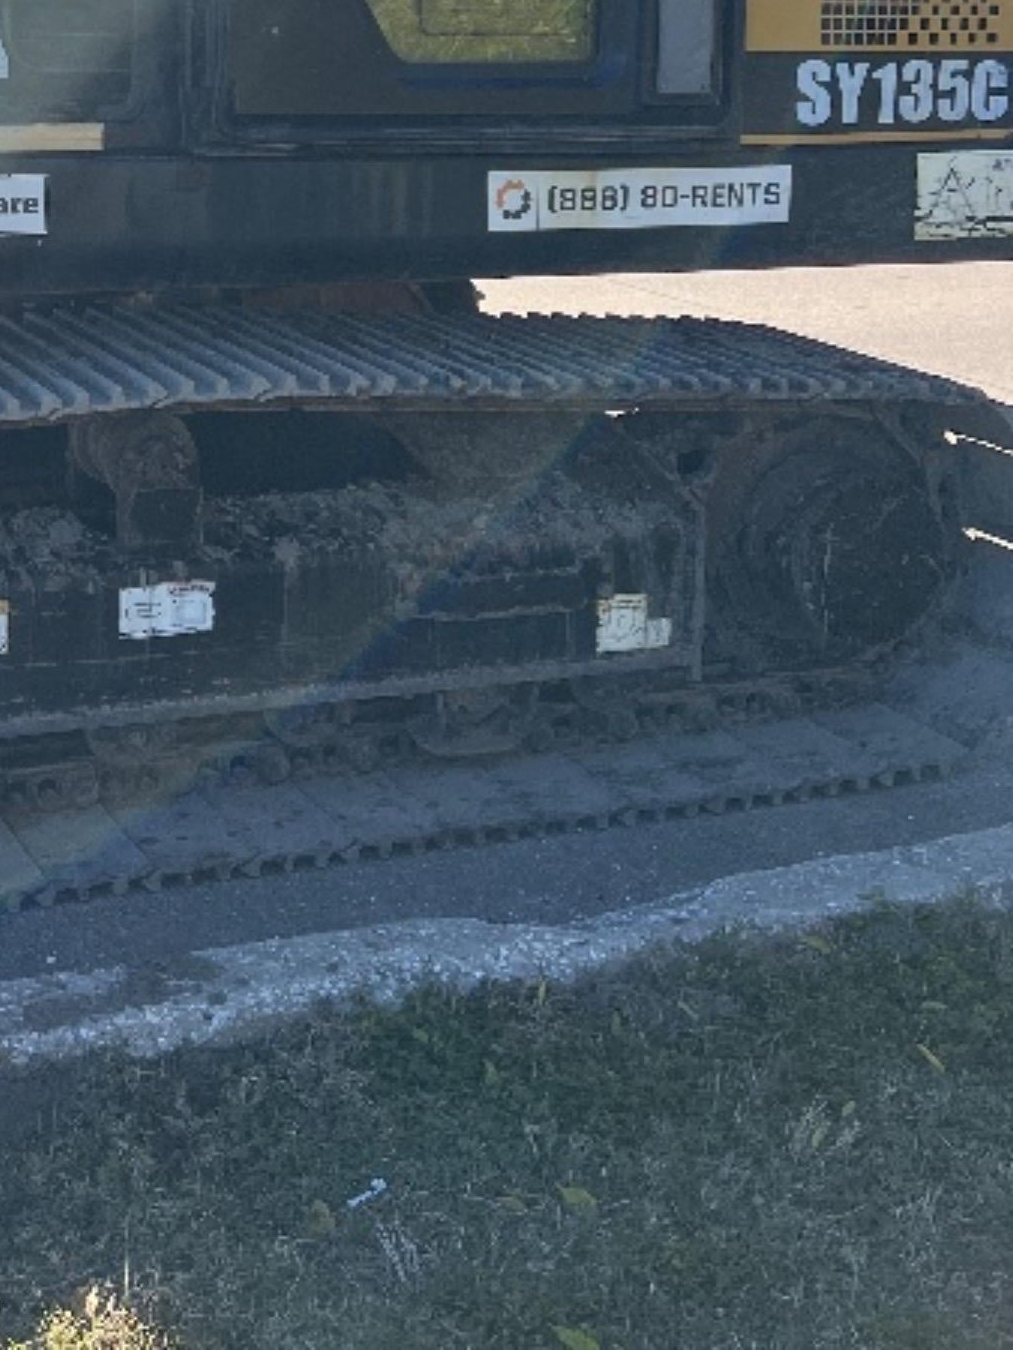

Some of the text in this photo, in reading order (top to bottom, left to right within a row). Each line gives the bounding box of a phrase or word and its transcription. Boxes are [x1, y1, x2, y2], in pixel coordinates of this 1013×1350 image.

[797, 59, 1008, 126] SY135C
[547, 182, 781, 213] (888) 80-RENTS
